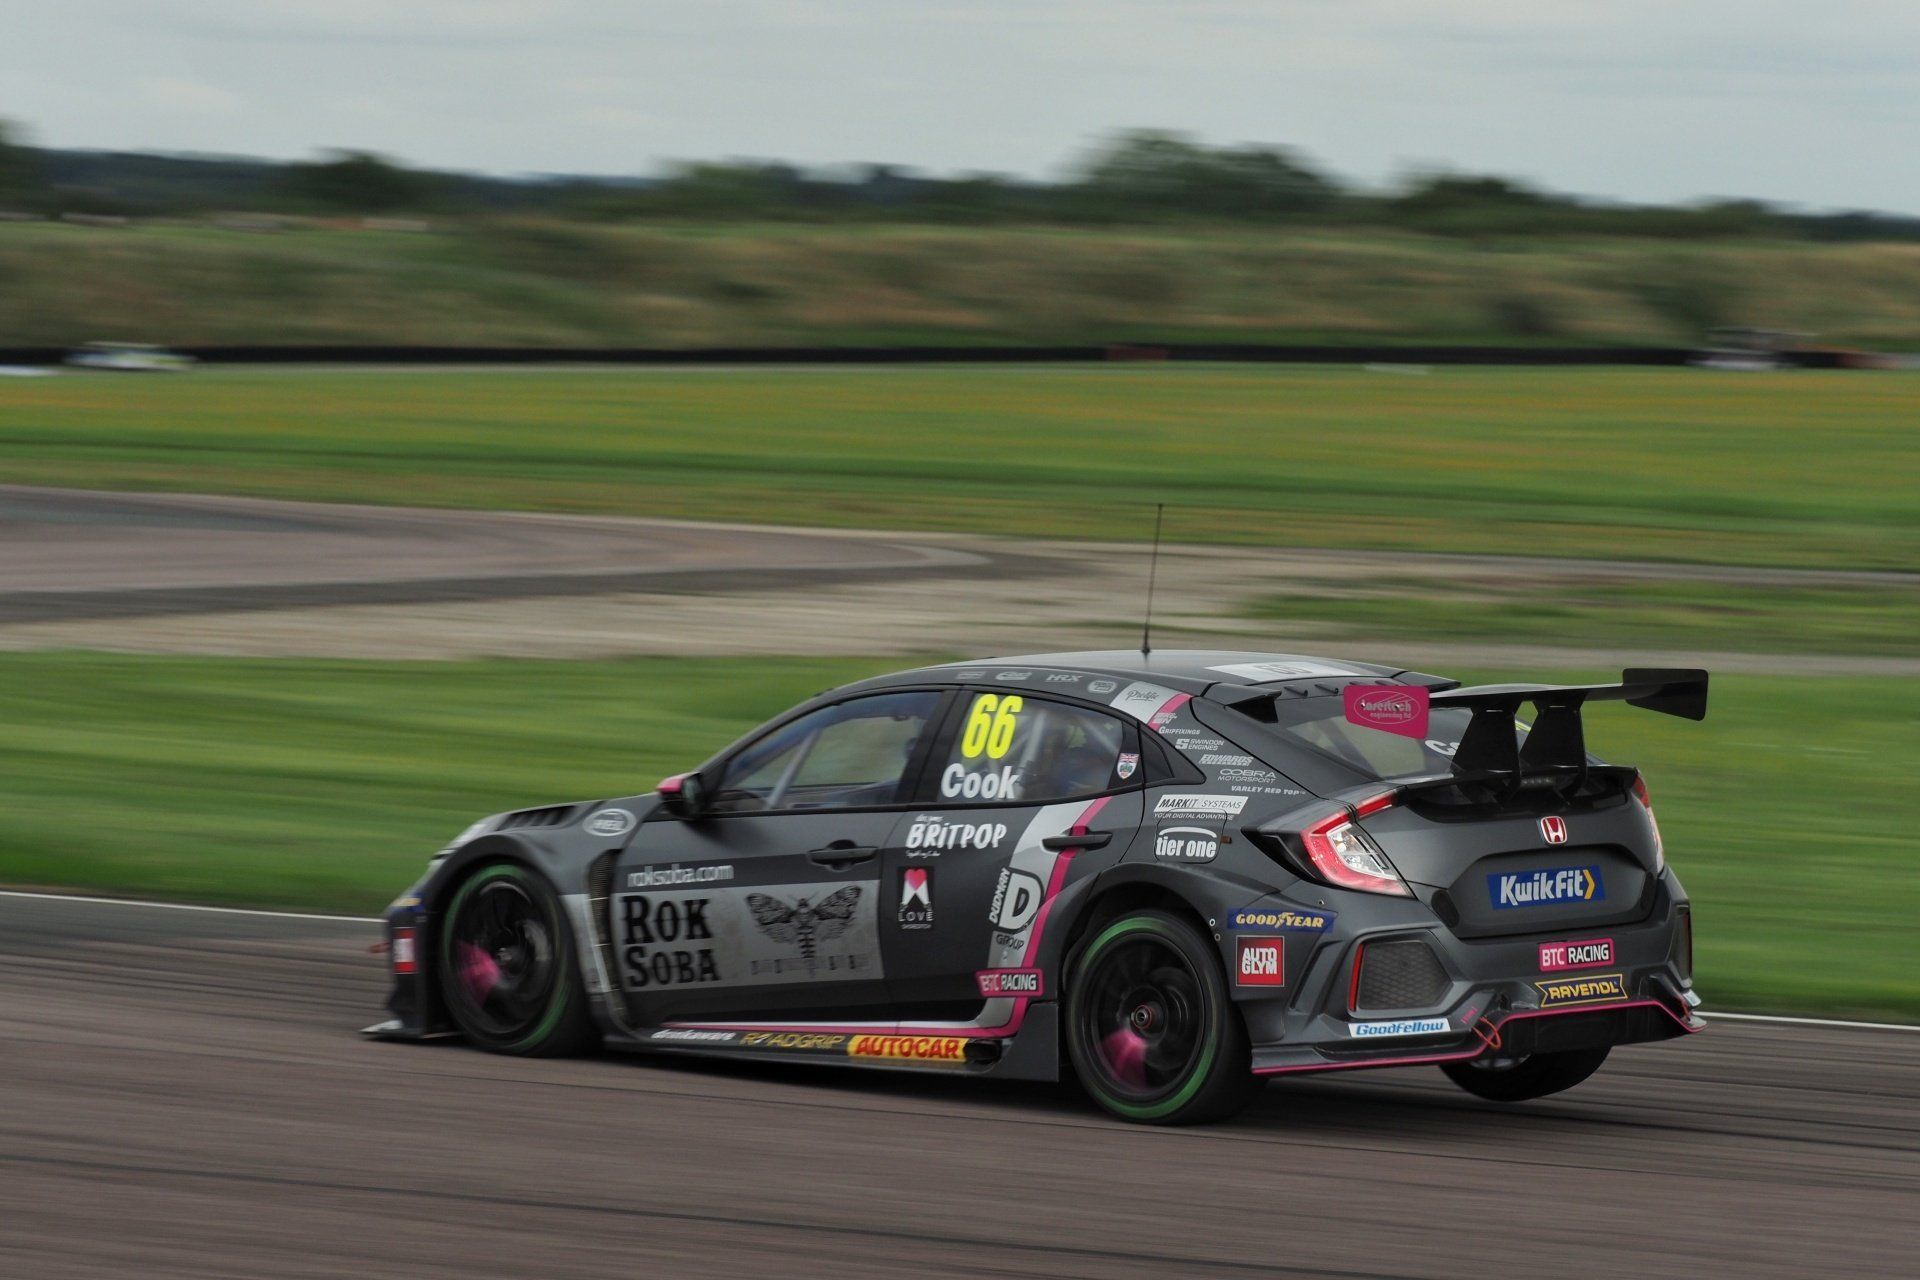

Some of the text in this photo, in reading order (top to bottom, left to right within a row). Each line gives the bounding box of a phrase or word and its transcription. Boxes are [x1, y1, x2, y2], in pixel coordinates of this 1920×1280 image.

[961, 693, 1023, 759] 66
[1200, 754, 1254, 763] EDWARDS
[941, 763, 1020, 799] Cook
[1217, 776, 1276, 784] MOTORSPORT
[1220, 768, 1277, 778] COBRA
[1159, 799, 1242, 809] MARKIT SYSTEMS
[1155, 836, 1217, 858] tier one
[898, 910, 934, 922] LOVE
[1236, 911, 1324, 929] GOODYEAR
[996, 934, 1024, 950] GROUP
[1242, 947, 1277, 962] AUTO
[1541, 943, 1610, 967] BTC RACING
[1241, 960, 1277, 975] GLYM
[1001, 974, 1037, 990] RACING
[855, 1036, 965, 1060] AUTOCAR
